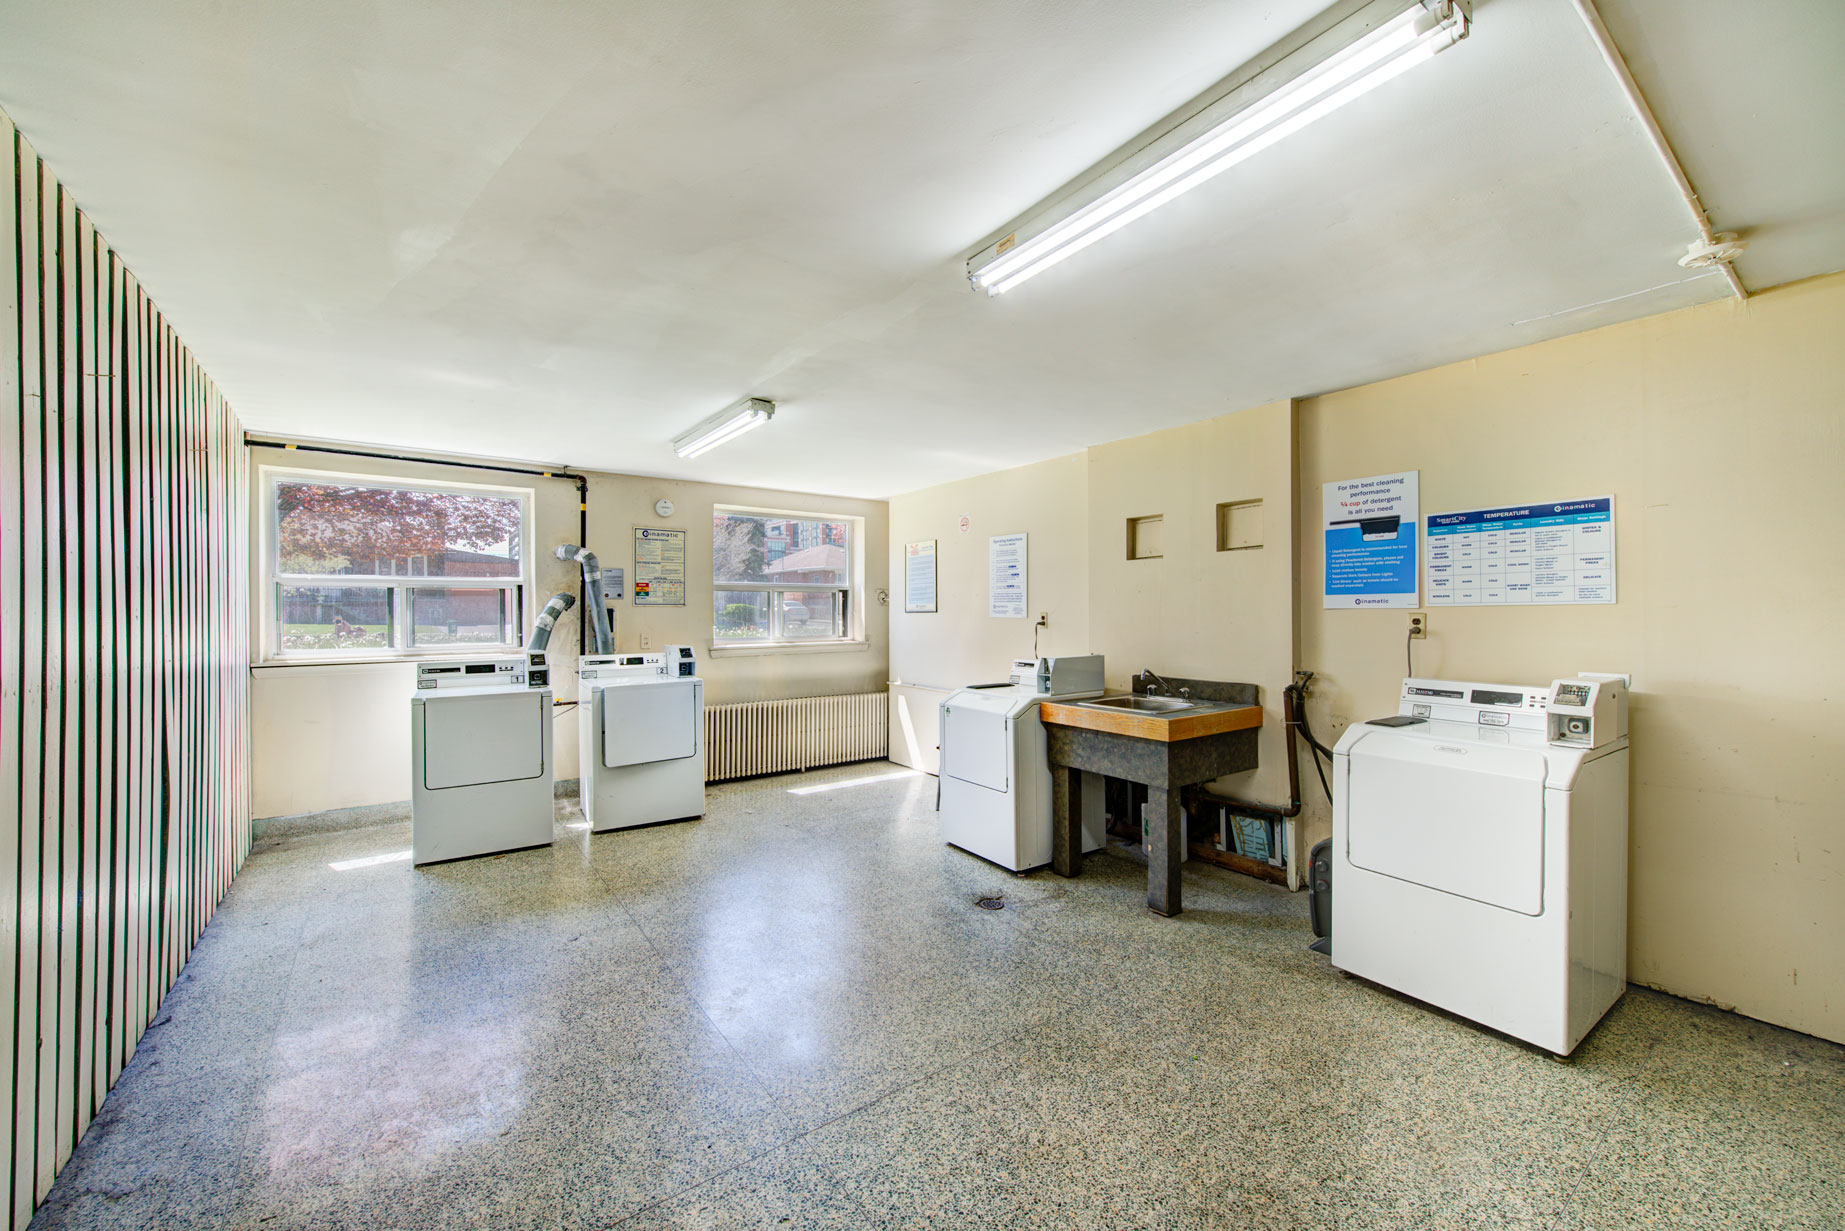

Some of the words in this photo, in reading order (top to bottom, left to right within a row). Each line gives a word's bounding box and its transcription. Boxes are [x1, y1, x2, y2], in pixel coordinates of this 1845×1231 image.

[1376, 478, 1404, 486] cleaning
[1350, 488, 1390, 498] performance
[1370, 496, 1401, 504] detergent
[1484, 510, 1529, 519] TEMPERATURE
